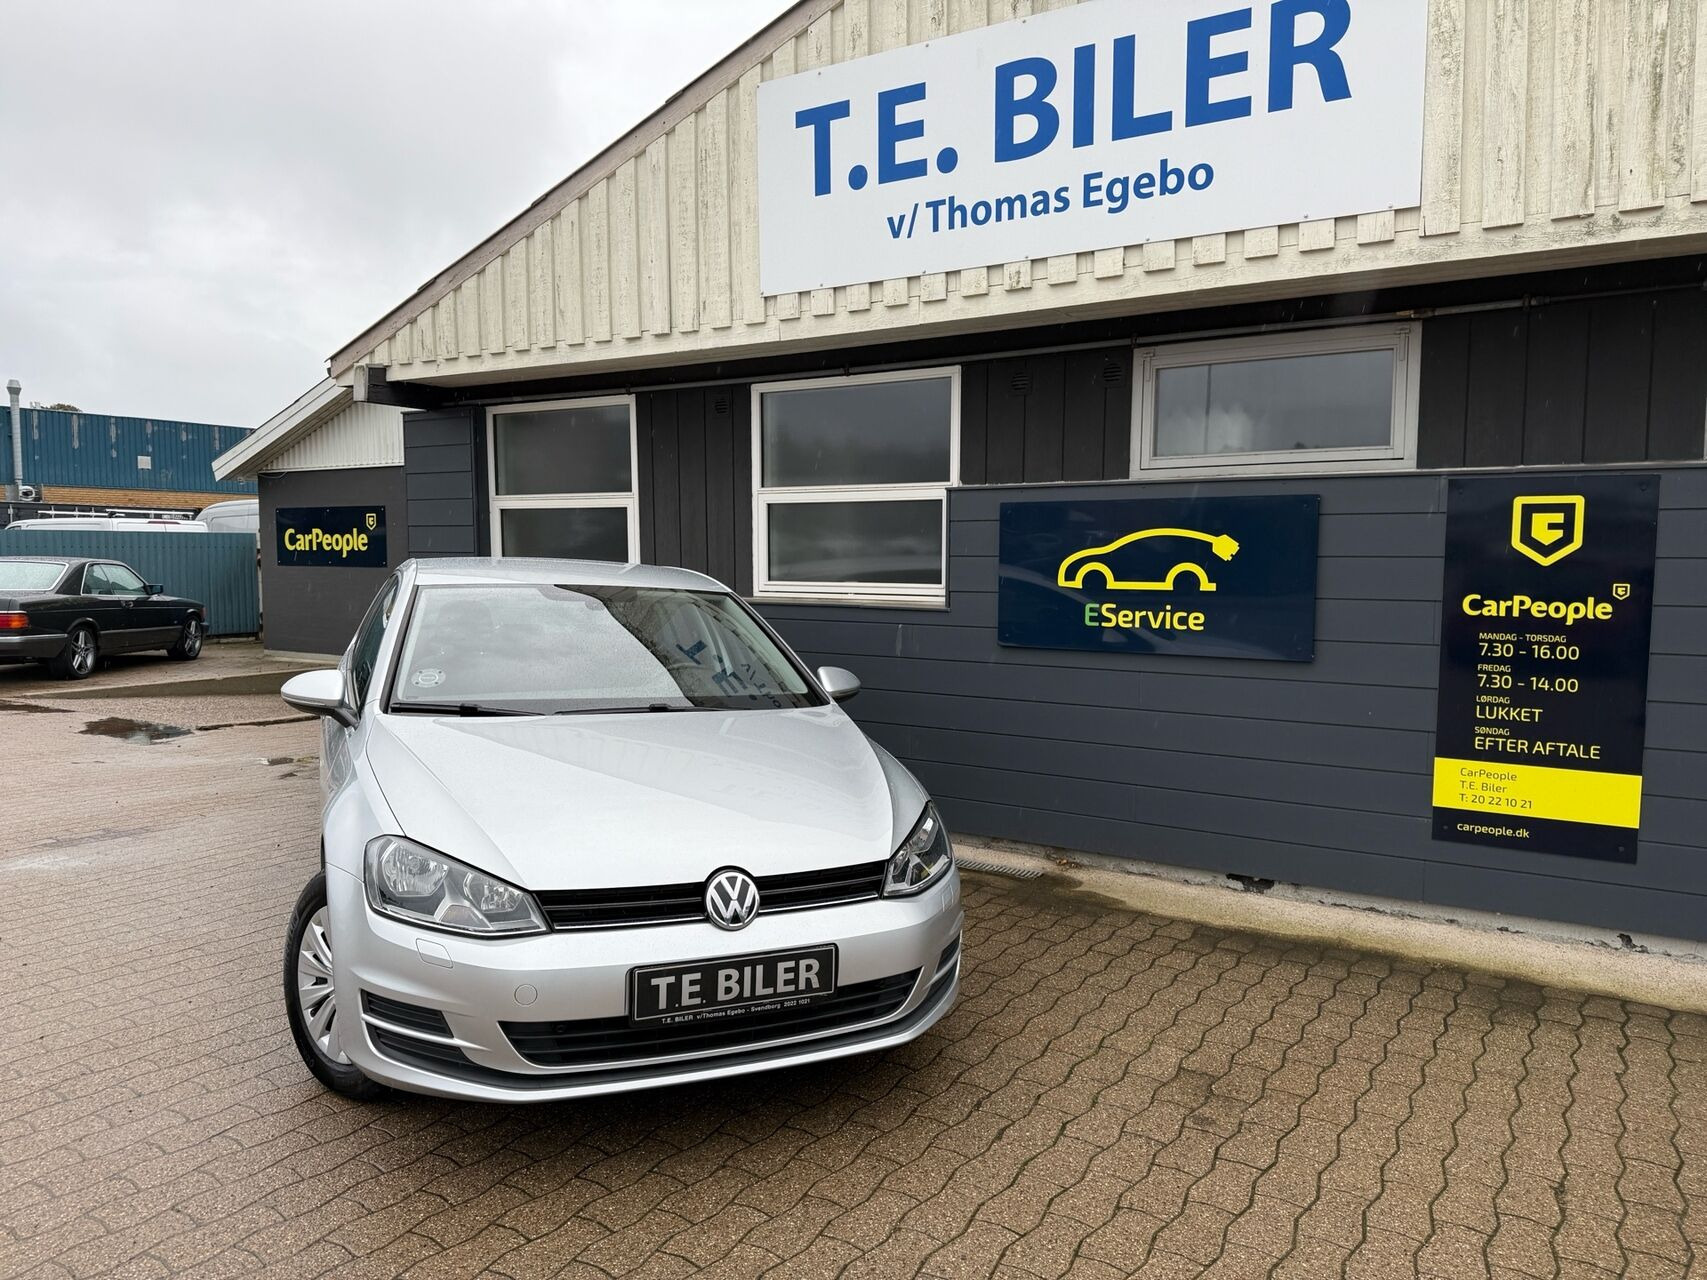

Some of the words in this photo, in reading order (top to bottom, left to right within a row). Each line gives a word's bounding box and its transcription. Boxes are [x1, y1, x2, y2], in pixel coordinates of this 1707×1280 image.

[795, 82, 959, 197] T.E.
[994, 0, 1352, 163] BILER
[888, 204, 918, 239] v/
[926, 187, 1070, 232] Thomas
[1083, 159, 1214, 214] Egebo
[284, 527, 368, 558] CarPeople
[1085, 603, 1204, 630] EService
[1462, 593, 1613, 626] CarPeople
[1525, 634, 1566, 642] TORSDAG
[1479, 643, 1513, 657] 7.30
[1532, 645, 1579, 660] 16.00
[1478, 664, 1511, 672] FREDAG
[1478, 674, 1512, 688] 7.30
[1531, 677, 1578, 692] 14.00
[1476, 695, 1511, 704] LØRDAG
[1476, 705, 1544, 723] LUKKET
[1475, 726, 1509, 735] SØNDAG
[1474, 736, 1529, 754] EFTER
[1532, 741, 1600, 759] AFTALE
[1460, 768, 1517, 782] CarPeople
[1460, 780, 1478, 790] T.E.
[1481, 783, 1507, 793] Biler
[1459, 793, 1468, 802] T:
[1471, 794, 1485, 804] 20
[1488, 796, 1501, 806] 22
[1505, 798, 1517, 807] 10
[1521, 800, 1531, 809] 21
[1457, 824, 1529, 838] carpeople.dk
[651, 973, 706, 1010] T.E.
[717, 958, 820, 1001] BILER
[674, 1014, 694, 1023] BILER
[751, 1003, 781, 1013] Svendborg
